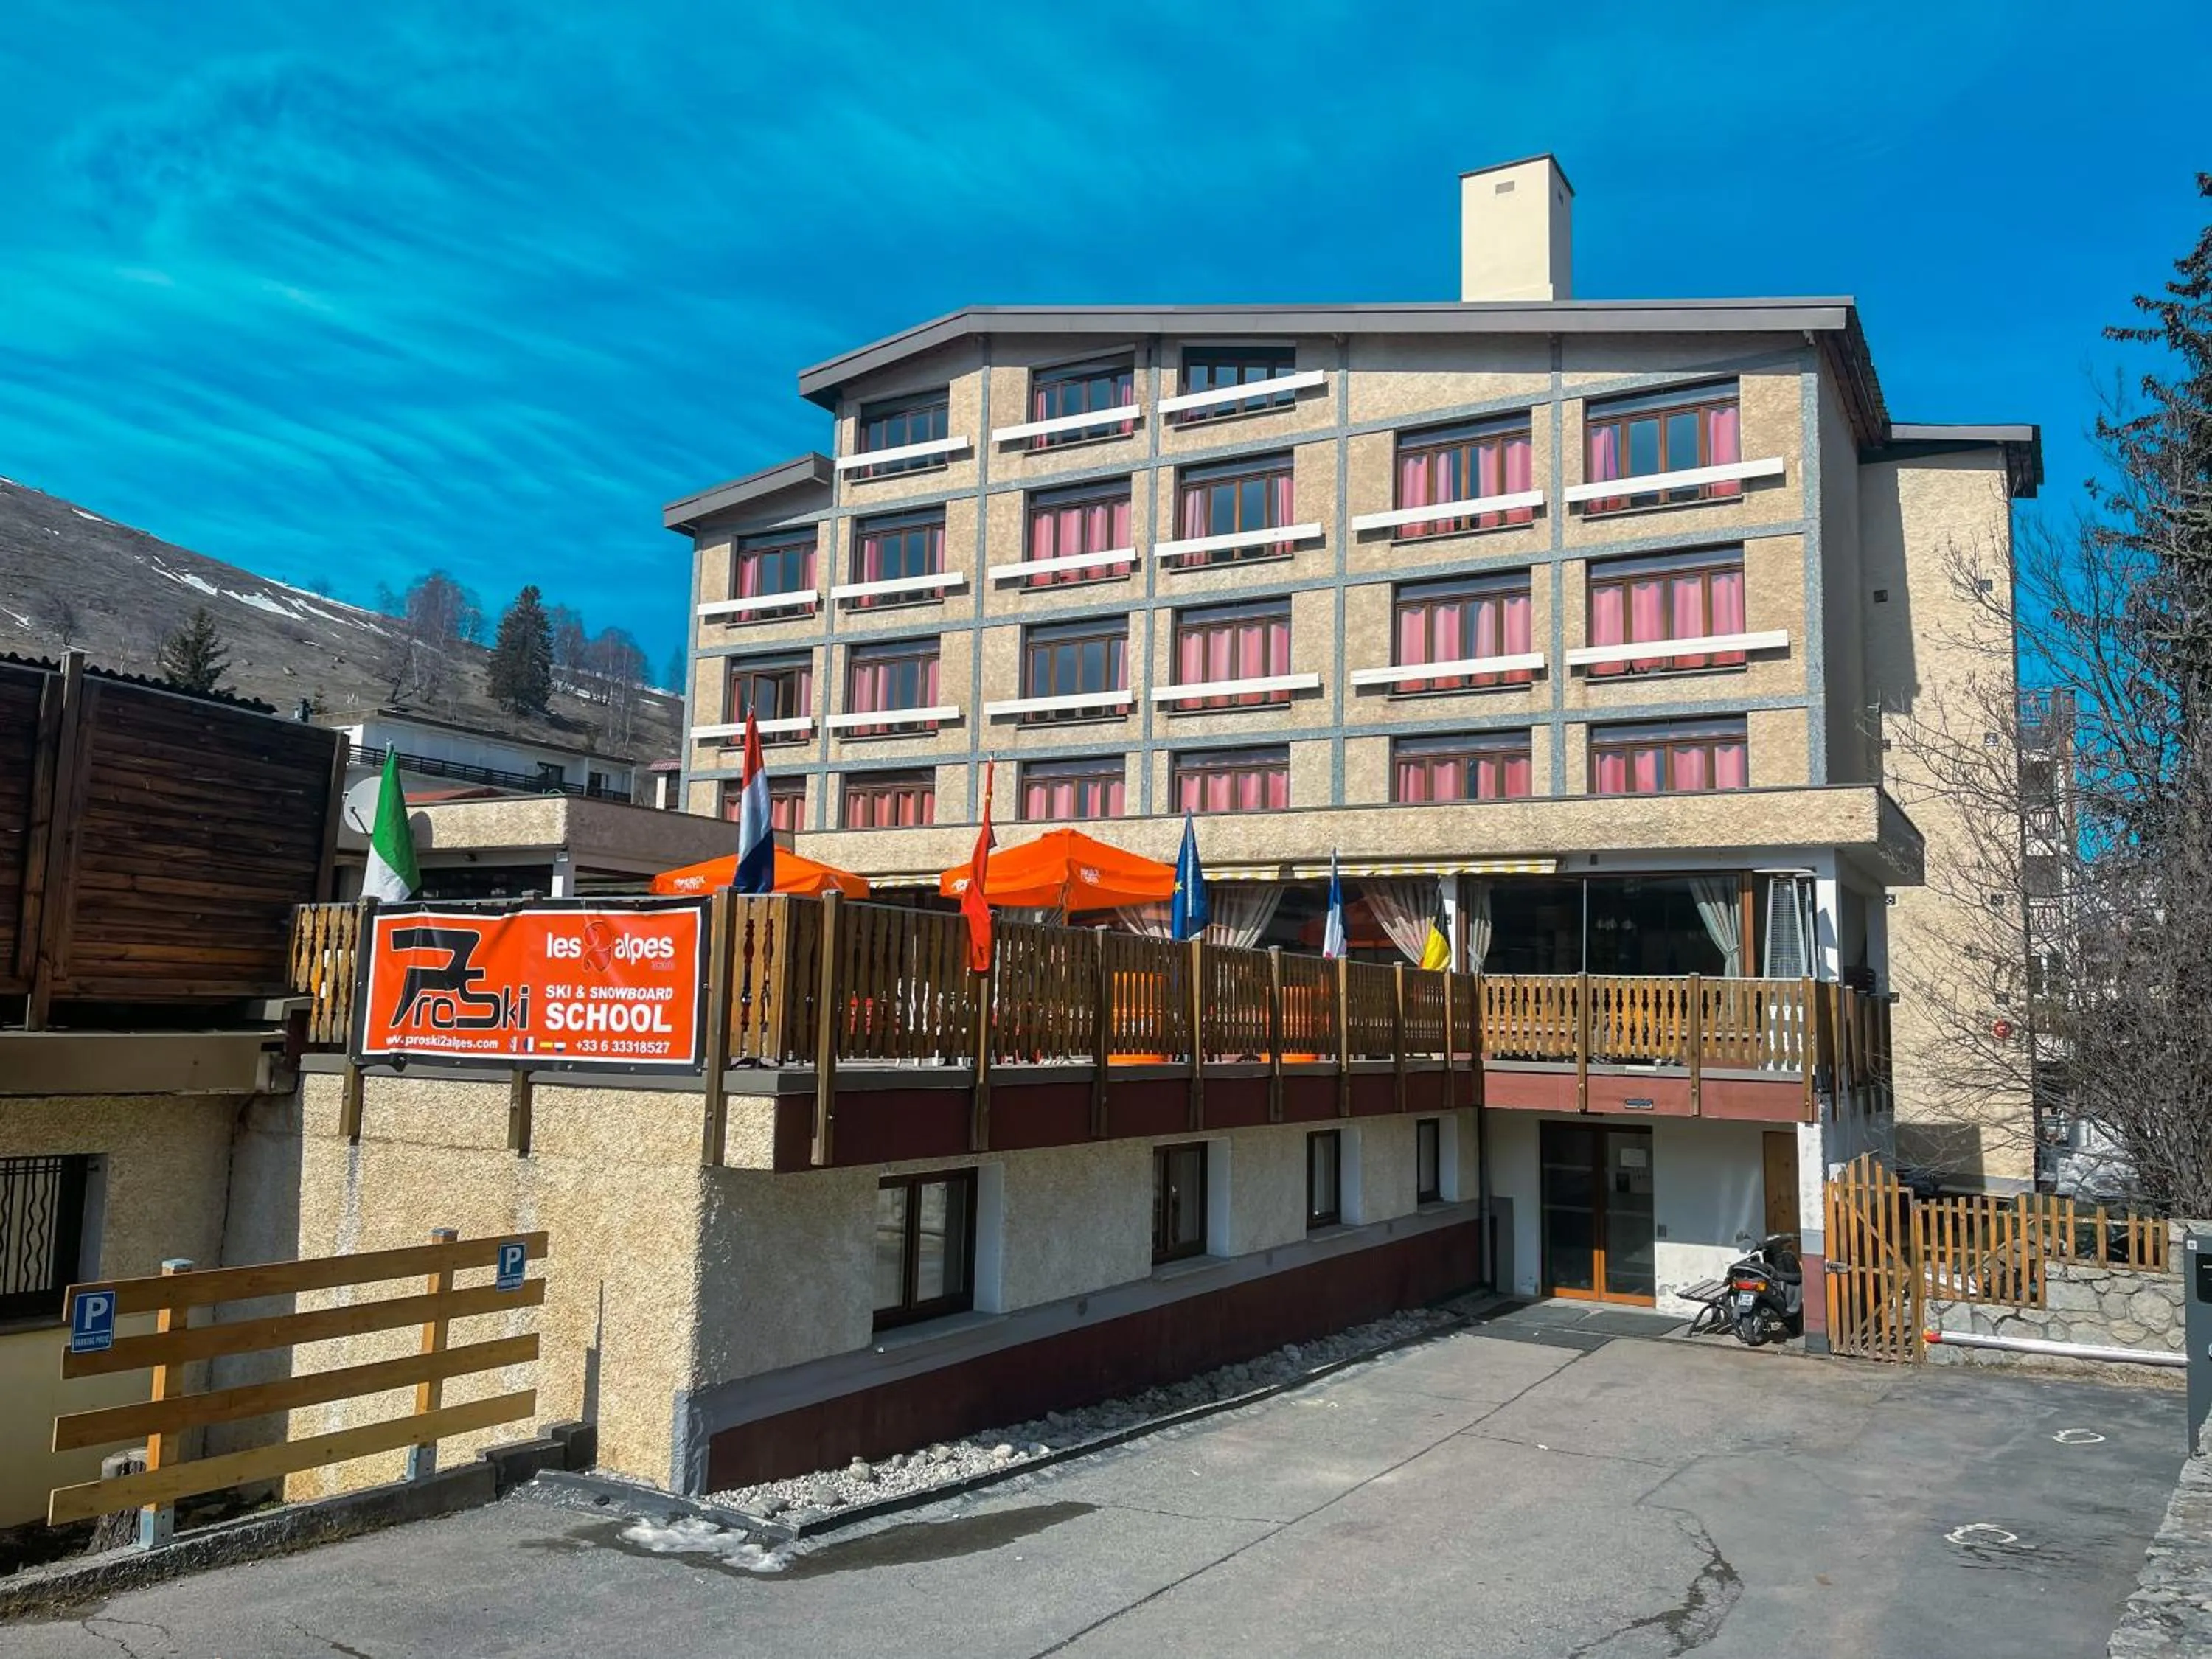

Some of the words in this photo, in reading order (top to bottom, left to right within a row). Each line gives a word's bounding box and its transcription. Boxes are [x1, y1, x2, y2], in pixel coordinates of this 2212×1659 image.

[546, 931, 582, 959] les
[614, 932, 675, 966] alpes
[545, 984, 571, 998] SKI
[576, 985, 585, 998] &
[590, 987, 673, 1001] SNOWBOARD
[544, 1002, 673, 1033] SCHOOL
[576, 1040, 597, 1052] +33
[601, 1040, 608, 1052] 6
[611, 1040, 671, 1054] 33318527
[505, 1247, 521, 1273] P
[85, 1297, 108, 1329] P
